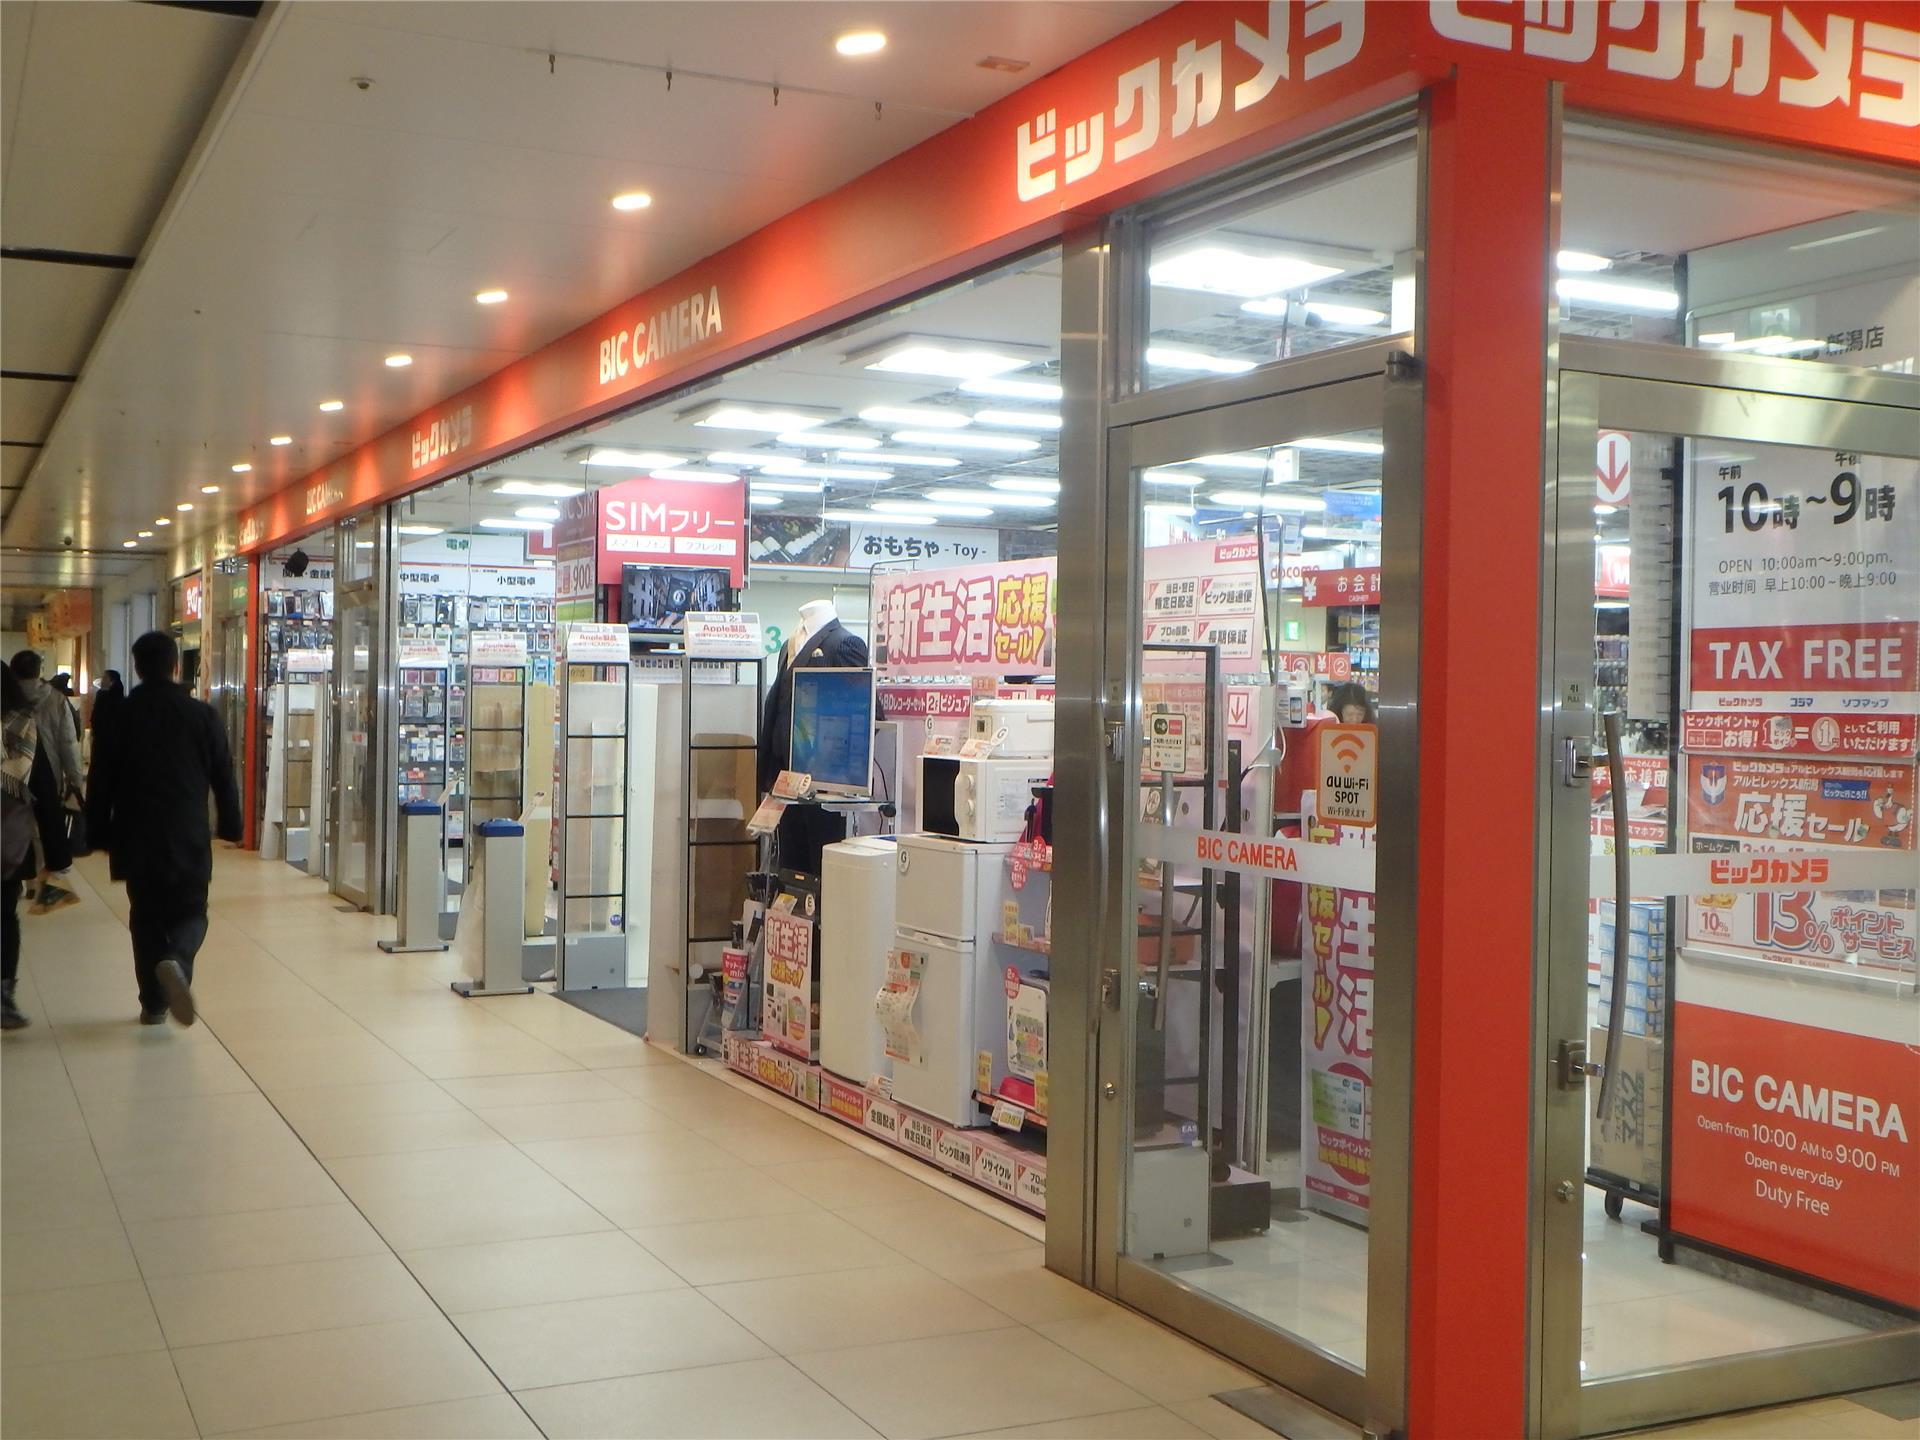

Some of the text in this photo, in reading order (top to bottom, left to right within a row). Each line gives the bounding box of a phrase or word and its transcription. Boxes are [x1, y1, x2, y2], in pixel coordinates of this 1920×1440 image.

[600, 285, 724, 385] BIC CAMERA
[605, 500, 736, 533] SIMフリー
[863, 535, 979, 561] おもちゃ Toy
[1718, 559, 1753, 573] OPEN
[997, 575, 1049, 624] 応援
[887, 578, 993, 664] 新生活
[1709, 638, 1902, 679] TAX FREE
[1789, 697, 1814, 707] コジマ
[1334, 790, 1359, 804] SPOT
[1197, 836, 1298, 871] BIC CAMERA
[1710, 858, 1829, 885] ビックカメラ
[1830, 906, 1905, 934] ポイント
[1691, 1060, 1909, 1143] BIC CAMERA
[1697, 1114, 1900, 1177] Open from 10:00 AM to 9:00 PM
[1744, 1151, 1843, 1190] Open everyday
[1756, 1179, 1830, 1217] Duty Free
